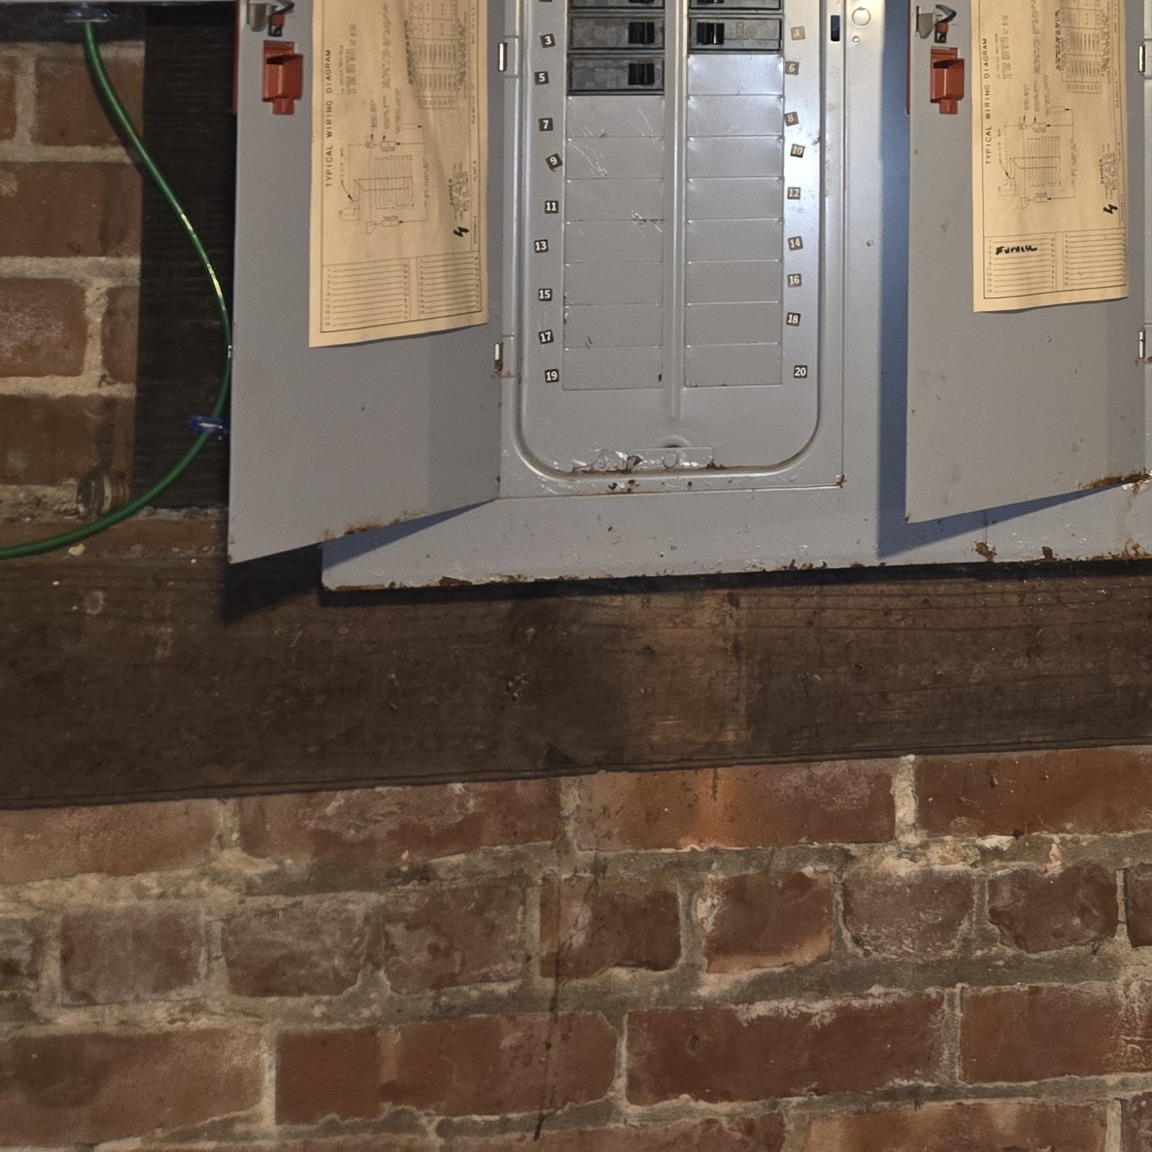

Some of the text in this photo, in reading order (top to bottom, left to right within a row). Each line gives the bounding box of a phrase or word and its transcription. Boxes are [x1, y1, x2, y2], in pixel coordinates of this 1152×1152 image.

[544, 35, 552, 45] 3
[788, 63, 796, 73] 6
[538, 72, 546, 82] 5
[787, 113, 795, 123] 8
[542, 119, 549, 130] 7
[792, 145, 804, 156] 10
[549, 156, 558, 166] 9
[788, 188, 800, 198] 12
[546, 201, 557, 212] 11
[535, 240, 547, 251] 13
[790, 238, 801, 248] 14
[789, 275, 800, 286] 16
[538, 289, 551, 299] 15
[787, 314, 799, 324] 18
[540, 331, 551, 342] 17
[546, 370, 558, 381] 19
[794, 366, 807, 377] 20
